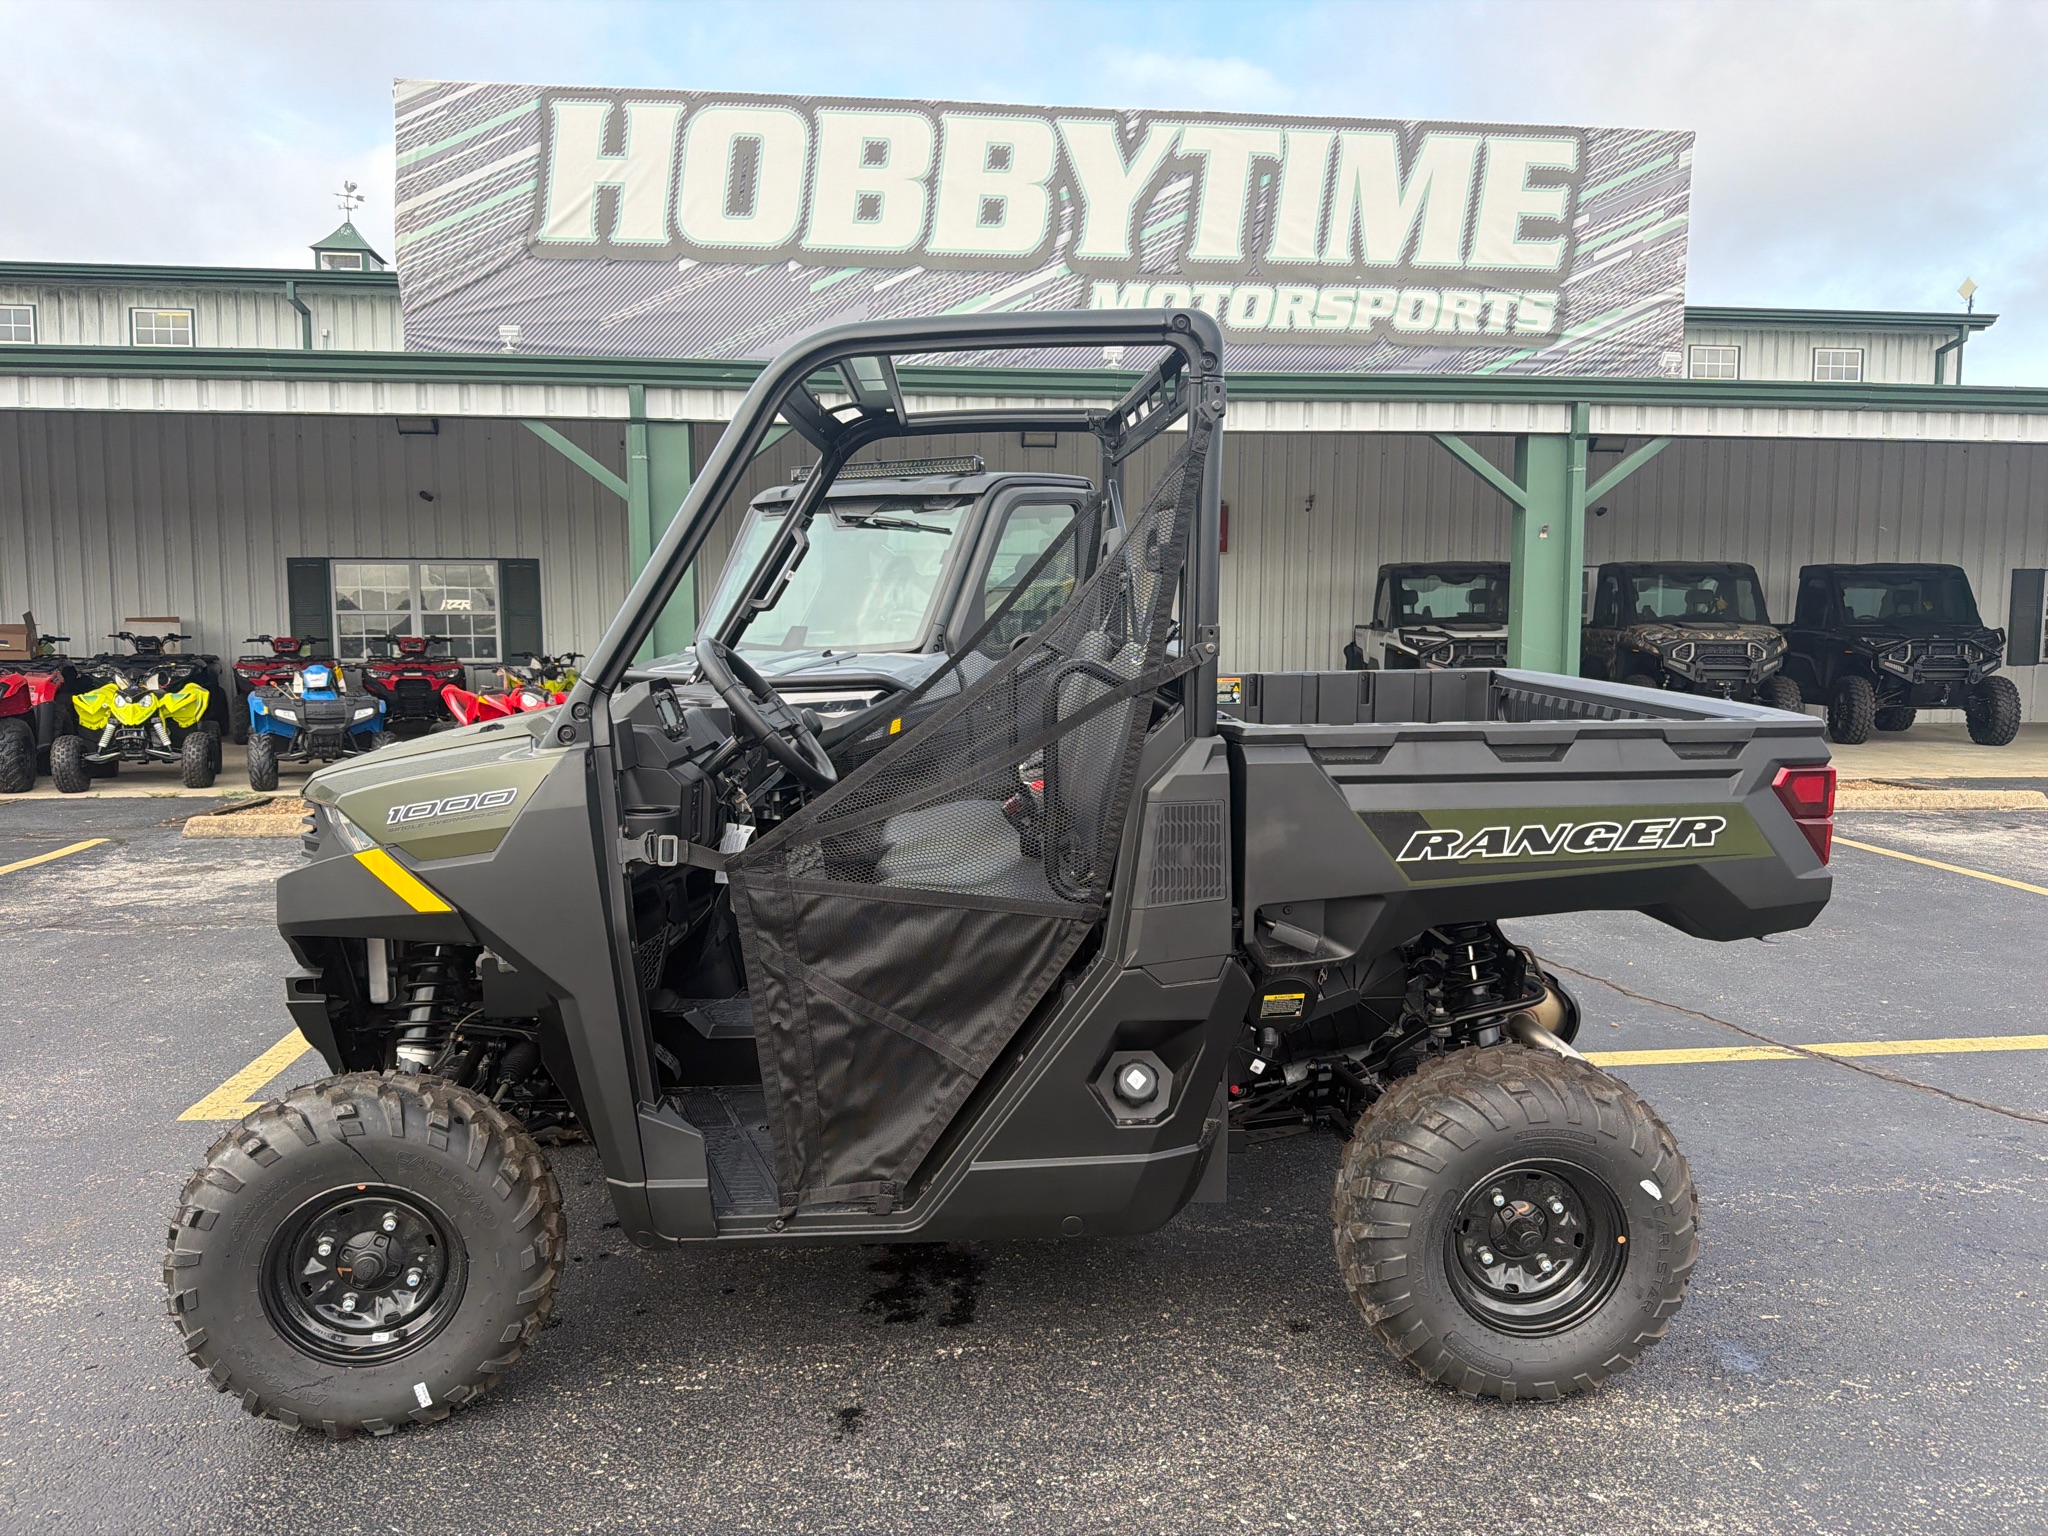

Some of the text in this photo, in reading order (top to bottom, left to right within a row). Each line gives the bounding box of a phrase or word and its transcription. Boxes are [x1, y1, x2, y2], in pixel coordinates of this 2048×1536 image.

[536, 100, 1579, 270] HOBBYTIME
[1089, 282, 1559, 333] MOTORSPORTS
[386, 787, 518, 825] 1000
[387, 808, 512, 833] SINGLE OVERHEAD CAM
[1395, 815, 1727, 862] RANGER
[1639, 1204, 1670, 1313] CARLSTAR
